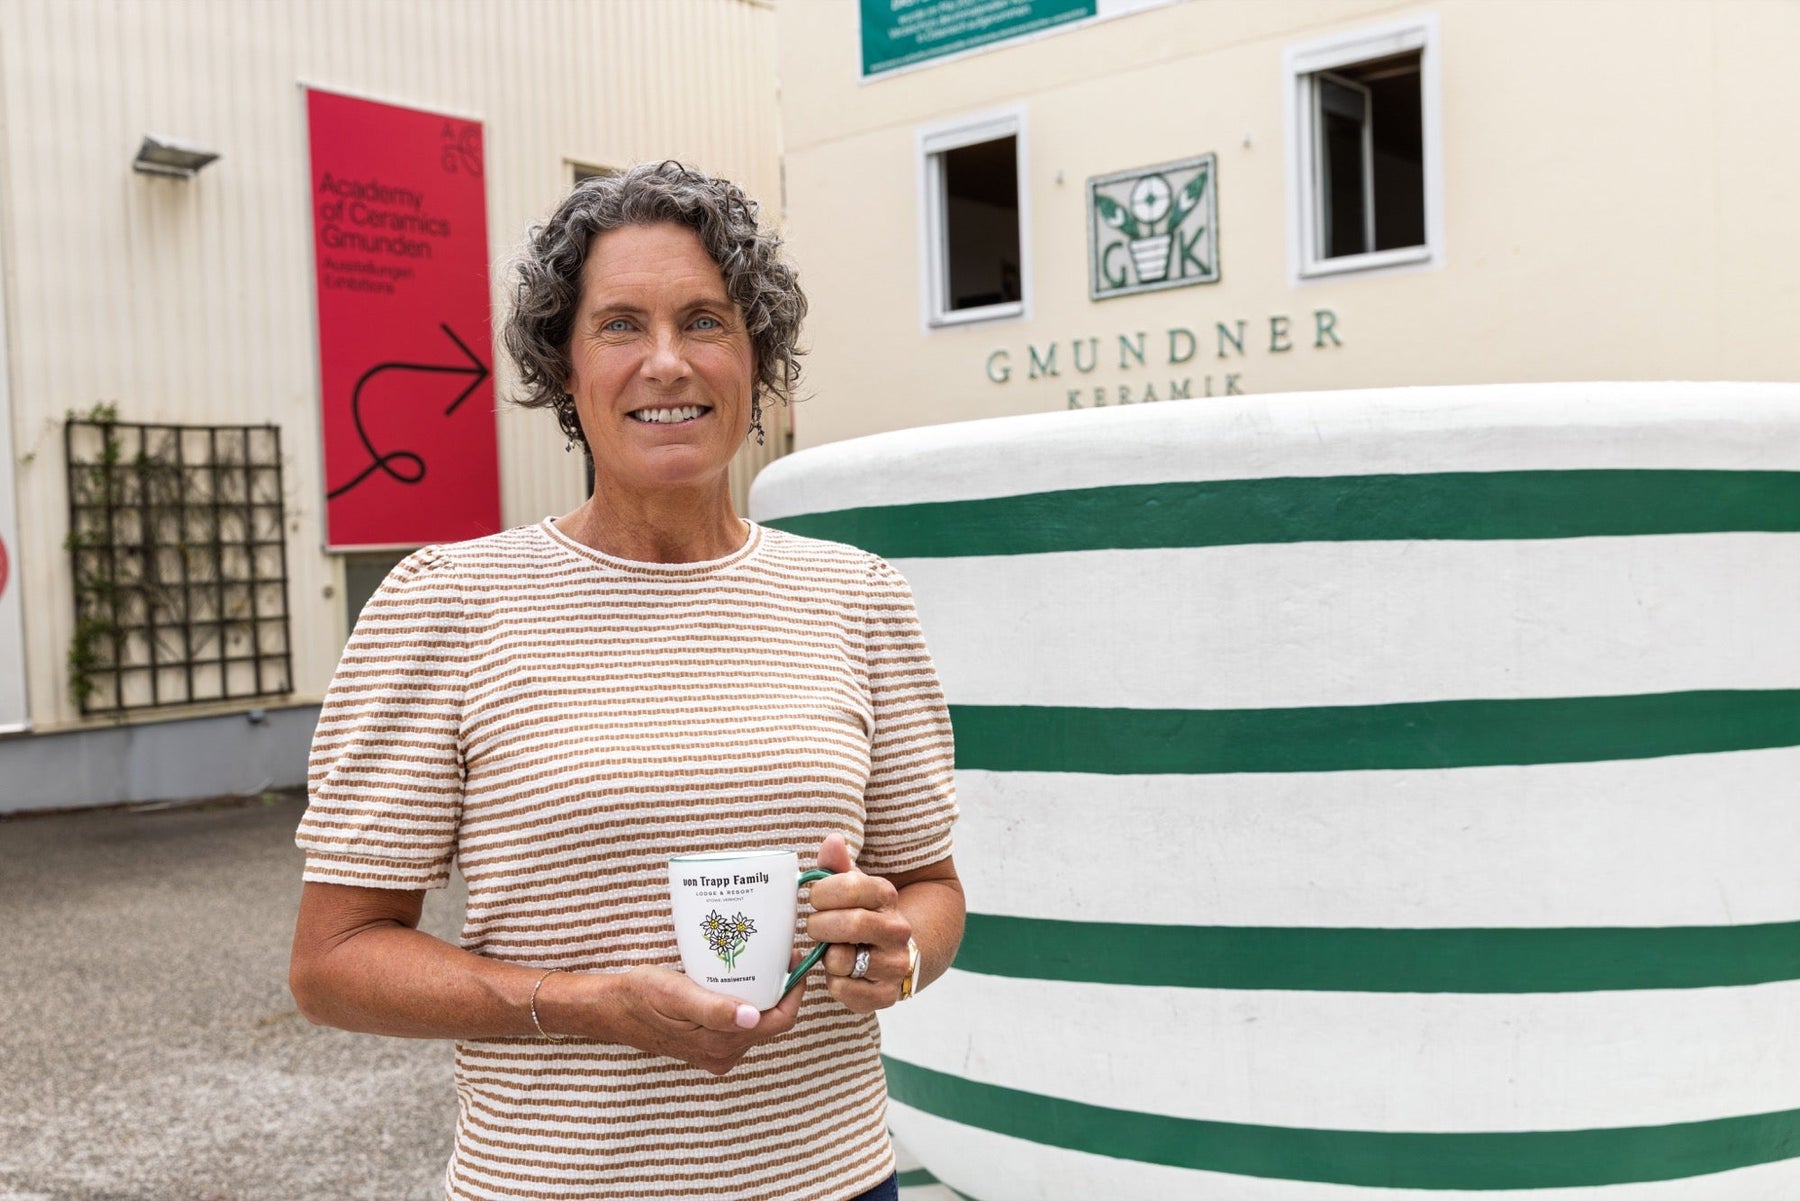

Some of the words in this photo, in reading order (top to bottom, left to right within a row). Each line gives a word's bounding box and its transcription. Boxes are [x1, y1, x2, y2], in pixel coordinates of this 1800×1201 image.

[319, 171, 424, 210] Academy
[320, 200, 344, 222] of
[349, 201, 450, 238] Ceramics
[321, 223, 433, 260] Gmunden
[1179, 226, 1212, 279] K
[985, 308, 1344, 385] GMUNDNER
[1066, 372, 1244, 410] KERAMIK
[682, 878, 698, 887] von
[699, 876, 730, 888] Trapp
[733, 871, 769, 885] Family
[720, 975, 756, 983] anniversary
